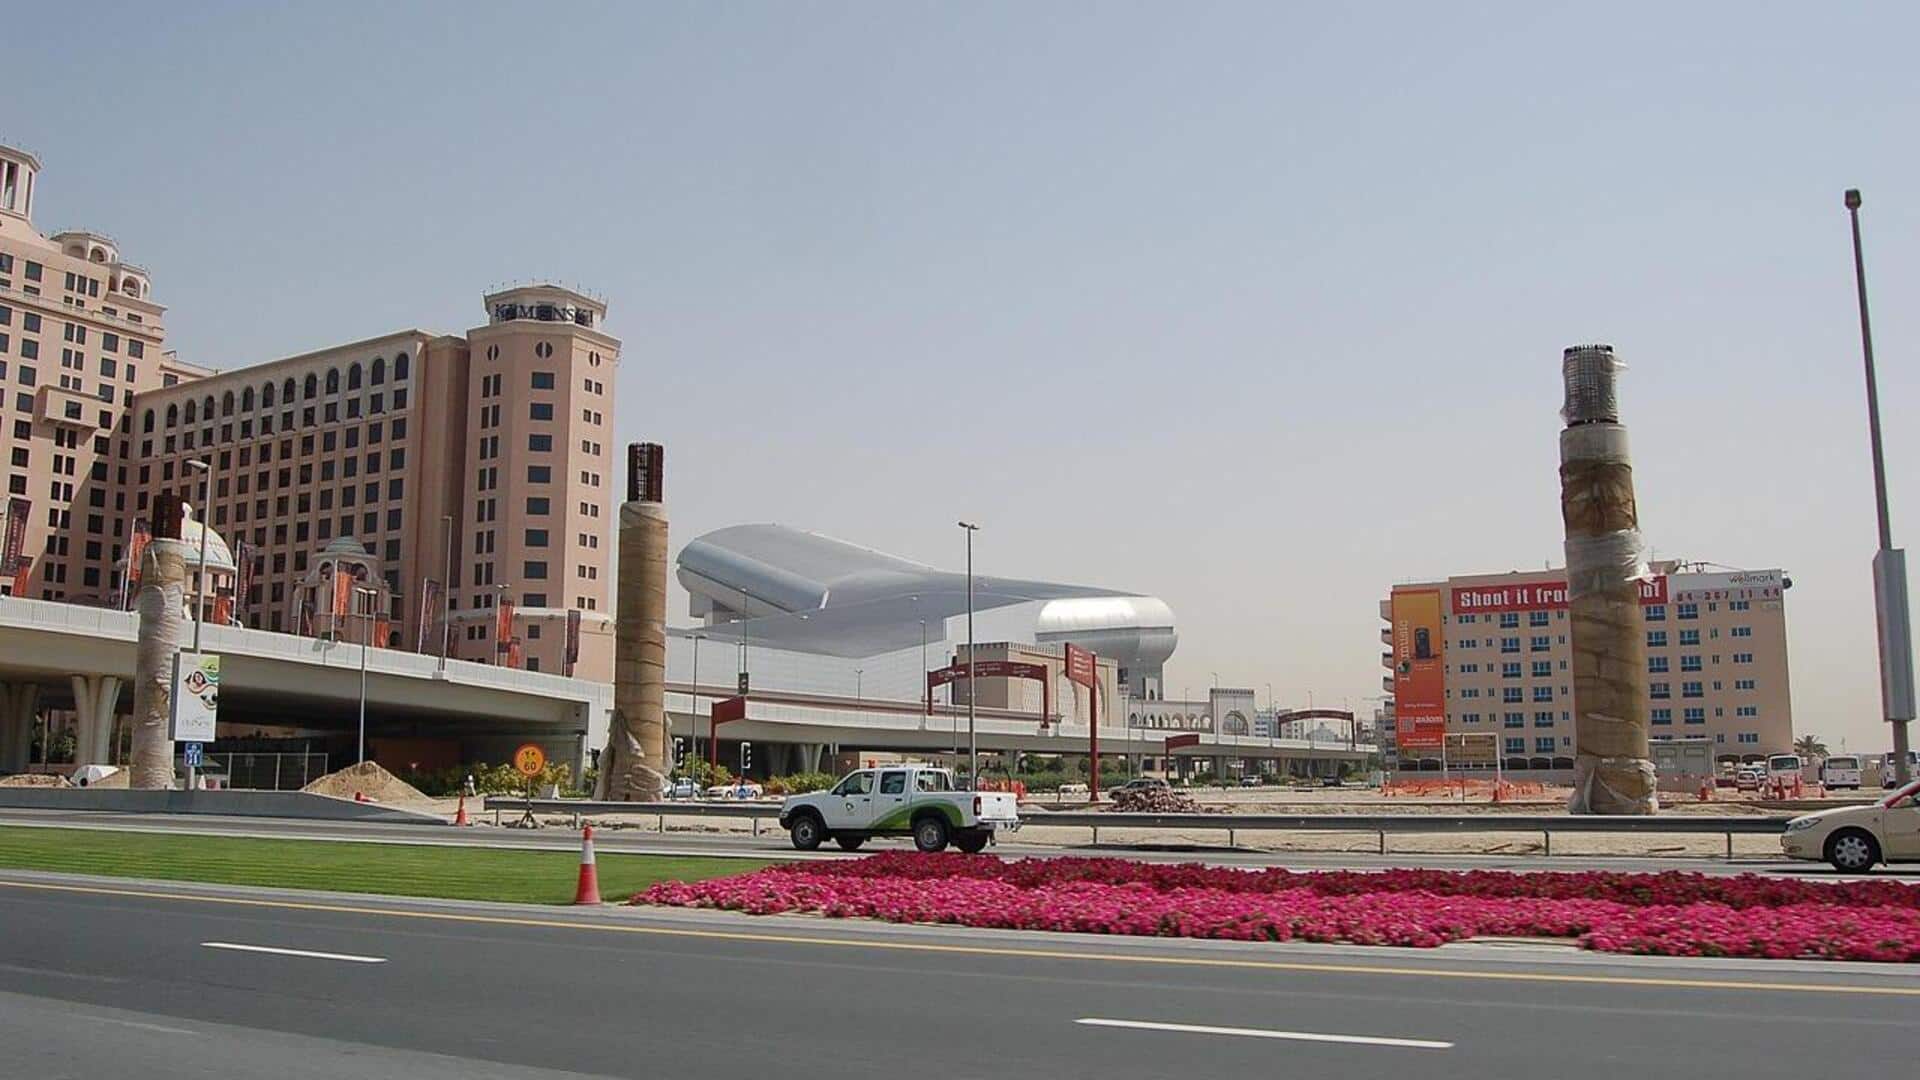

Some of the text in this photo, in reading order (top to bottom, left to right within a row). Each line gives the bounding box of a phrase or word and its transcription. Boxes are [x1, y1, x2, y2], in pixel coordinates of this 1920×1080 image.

[495, 303, 593, 328] KEMNSKI
[1729, 572, 1775, 584] wellmark
[1460, 590, 1509, 607] Shoot
[1517, 588, 1529, 604] it
[524, 761, 537, 771] 60
